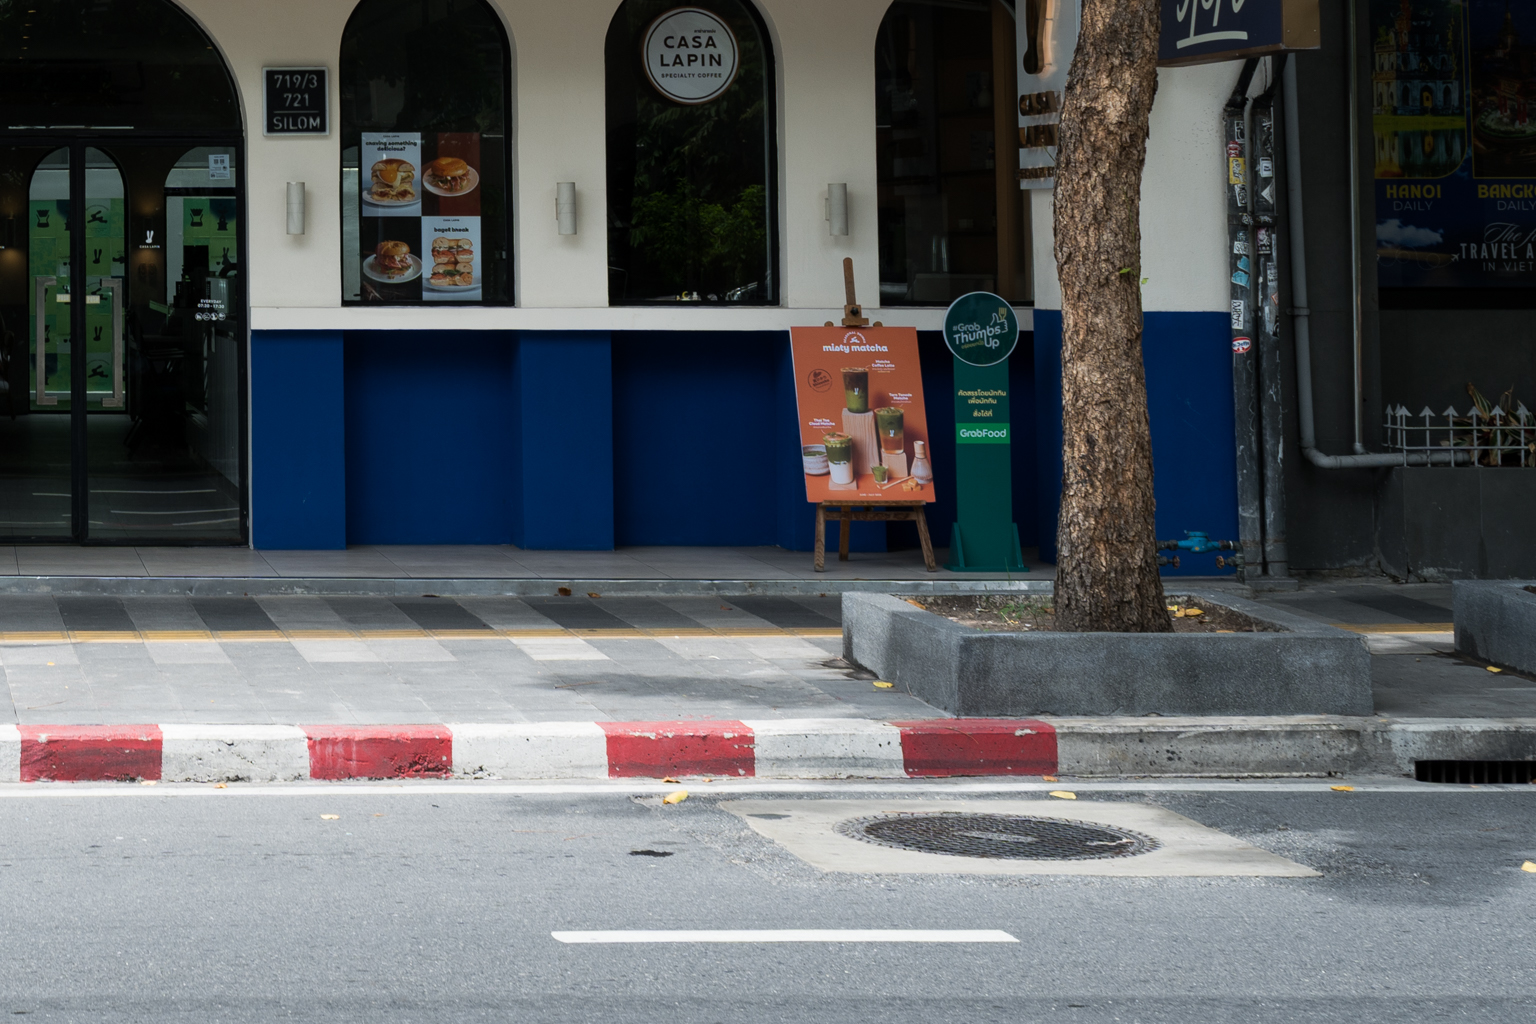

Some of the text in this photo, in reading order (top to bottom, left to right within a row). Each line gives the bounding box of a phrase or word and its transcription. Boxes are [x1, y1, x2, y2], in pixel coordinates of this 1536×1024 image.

[663, 35, 717, 49] CASA
[660, 53, 722, 67] LAPIN
[274, 73, 318, 89] 719/3
[283, 93, 309, 107] 721
[273, 116, 320, 130] SILOM
[1386, 183, 1442, 199] HANOI
[1477, 184, 1536, 199] BANGK
[1393, 200, 1433, 211] DAILY
[1497, 200, 1536, 211] DAILY
[1483, 222, 1522, 244] The
[1459, 242, 1518, 259] TRAVEL
[1482, 261, 1534, 272] IN VIET
[953, 322, 981, 332] #Grab
[953, 325, 1001, 345] Thumbs
[823, 343, 888, 354] misty matcha
[984, 337, 1000, 350] Up
[959, 428, 1007, 438] GrabFood
